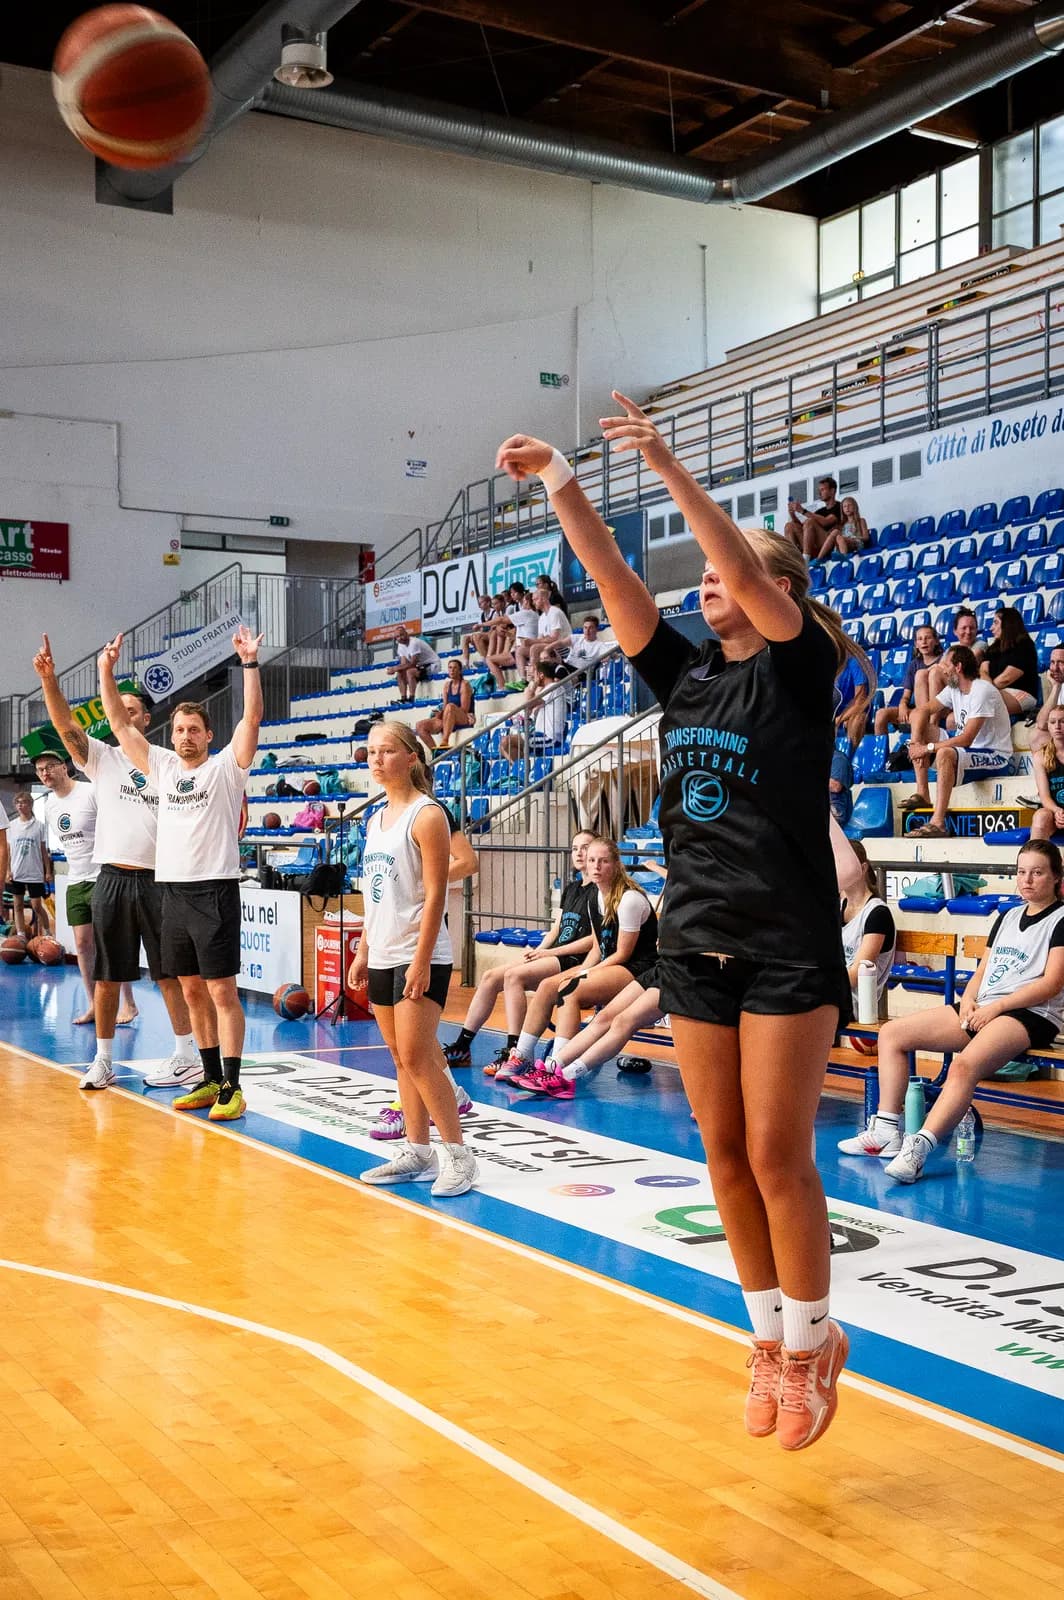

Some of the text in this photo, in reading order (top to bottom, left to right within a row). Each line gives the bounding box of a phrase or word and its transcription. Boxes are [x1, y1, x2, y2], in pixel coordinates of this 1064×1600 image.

[926, 427, 967, 465] Città
[971, 428, 986, 454] di
[990, 409, 1047, 449] Roseto
[423, 560, 480, 618] DGA
[171, 639, 202, 663] STUDIO
[202, 615, 241, 643] FRATTARI
[664, 727, 749, 755] TRANSFORMING
[662, 751, 759, 785] BASKETBALL
[242, 901, 278, 925] tu nel
[240, 931, 270, 952] QUOTE
[842, 1215, 904, 1235] PROJECT
[857, 1272, 1005, 1320] Vendita
